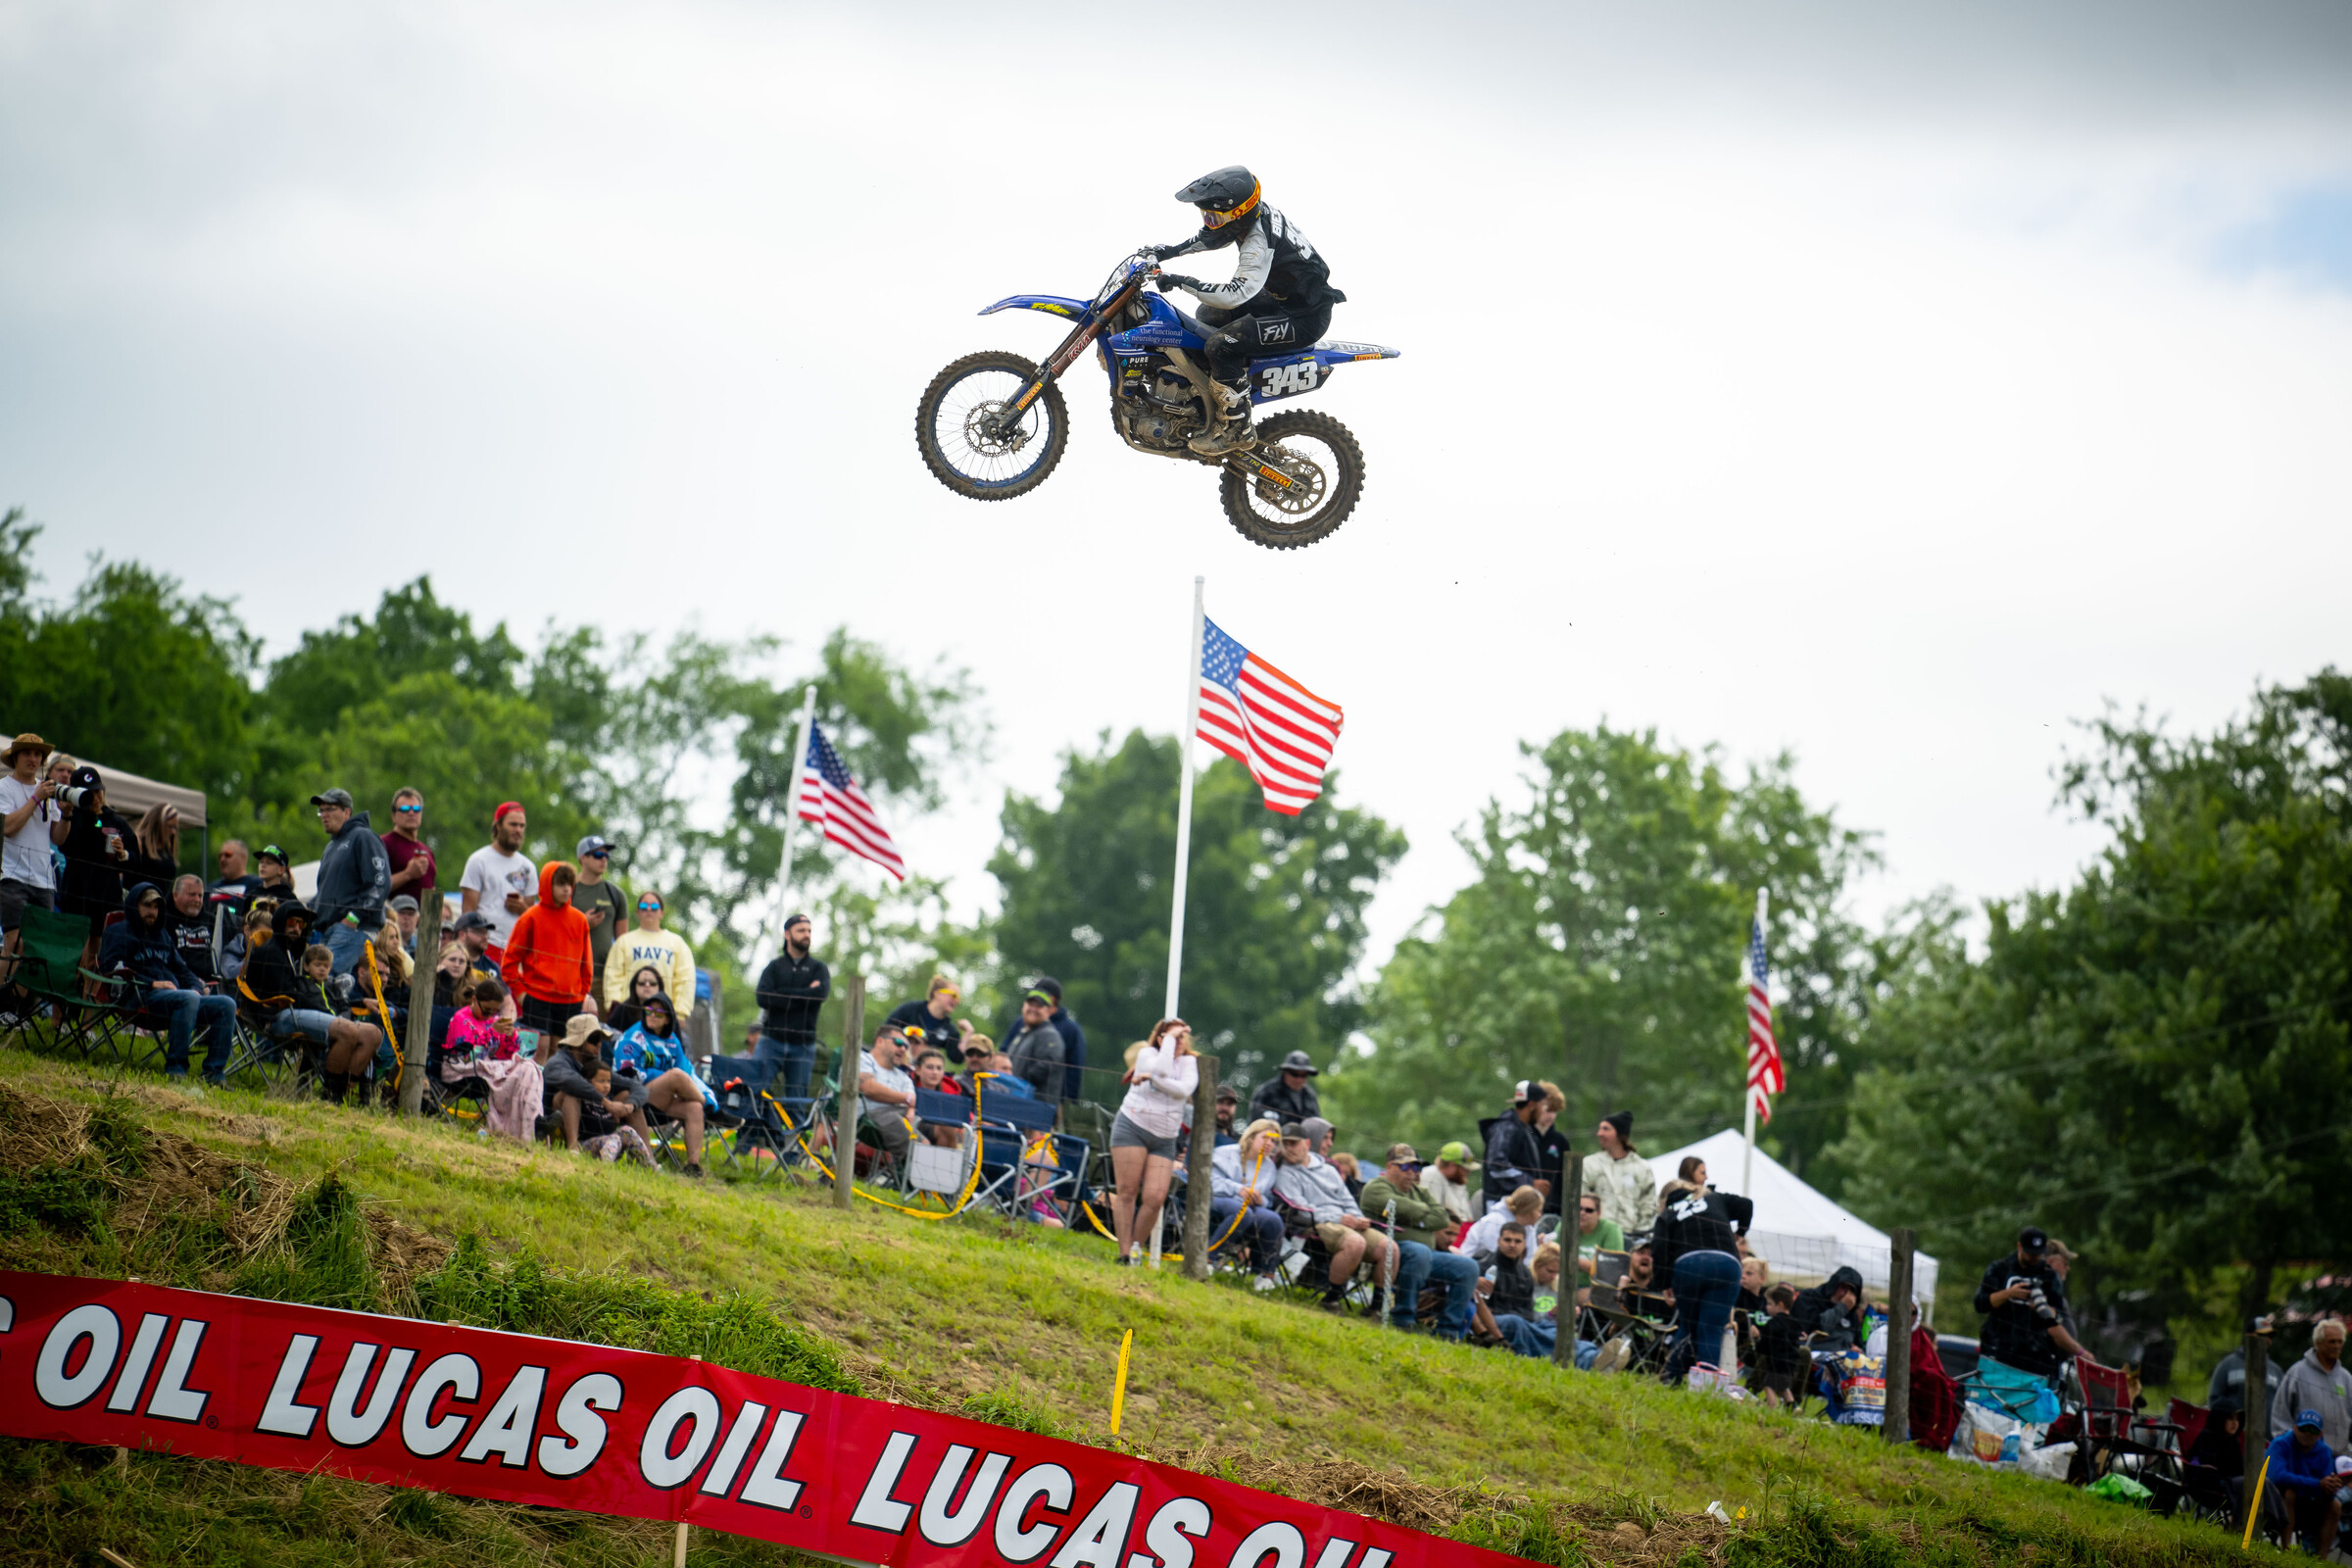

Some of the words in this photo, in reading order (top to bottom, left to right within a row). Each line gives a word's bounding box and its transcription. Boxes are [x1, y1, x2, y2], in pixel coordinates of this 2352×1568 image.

[1131, 335, 1161, 345] neurology
[1152, 327, 1183, 336] functional
[1263, 321, 1290, 342] FLY
[1260, 361, 1318, 398] 343
[1259, 466, 1292, 488] PIRELLI
[632, 946, 674, 965] NAVY
[1673, 1197, 1709, 1222] 23
[33, 1303, 213, 1426] OIL
[253, 1333, 625, 1481] LUCAS
[638, 1385, 809, 1514] OIL
[848, 1430, 1214, 1568] LUCAS
